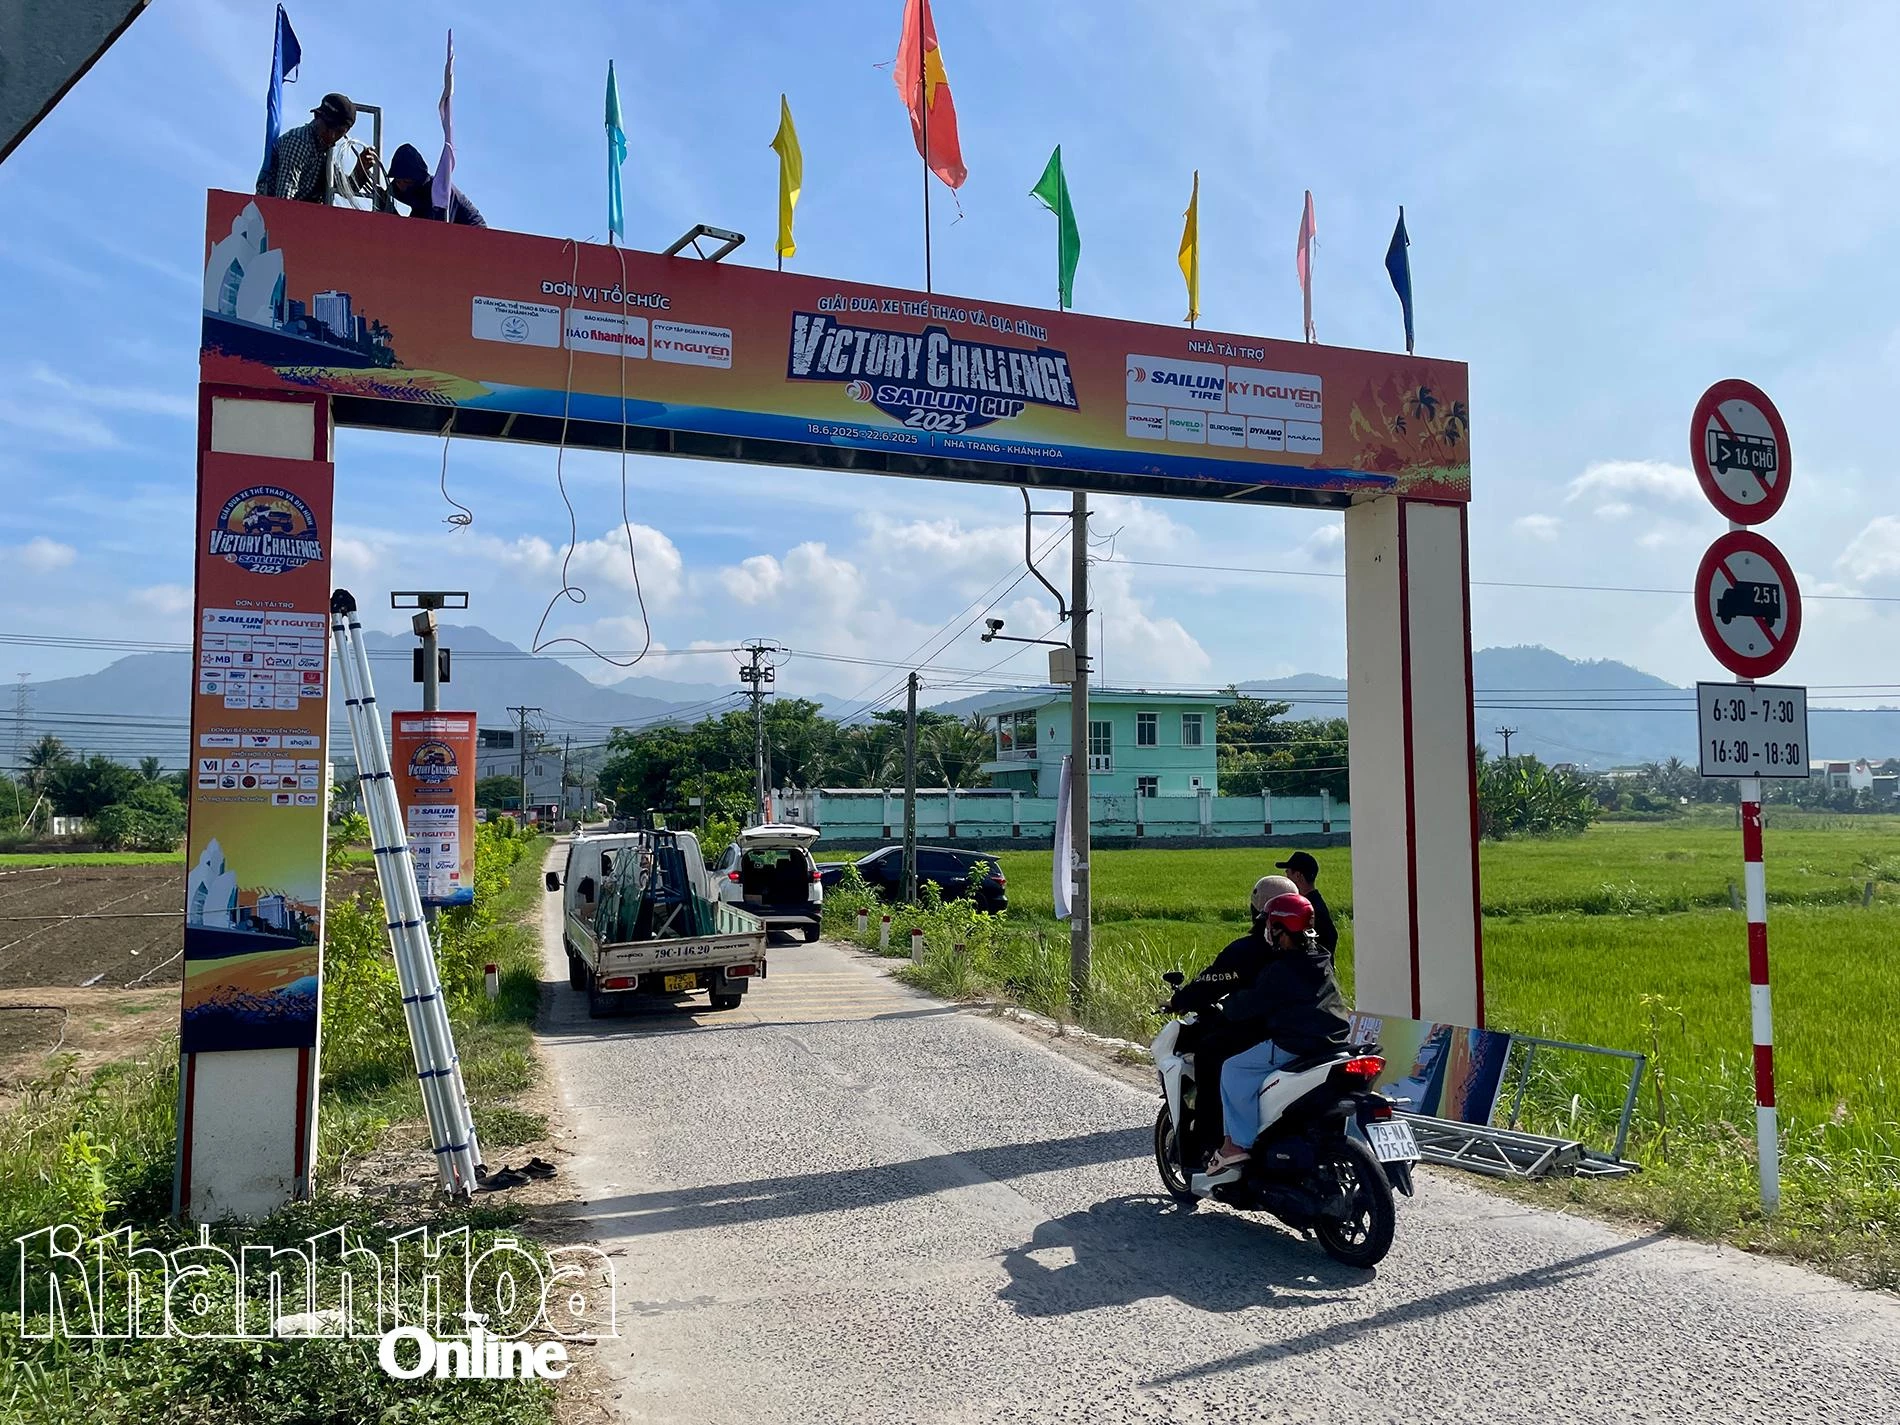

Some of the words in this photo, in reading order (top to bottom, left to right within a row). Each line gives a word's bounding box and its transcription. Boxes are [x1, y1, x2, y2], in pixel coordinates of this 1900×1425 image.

[542, 281, 578, 297] ĐƠN
[582, 286, 597, 303] VỊ
[600, 284, 623, 303] TỔ
[625, 292, 670, 309] CHỨC
[818, 293, 847, 311] GIẢI
[850, 297, 878, 312] ĐUA
[881, 299, 900, 314] XE
[902, 299, 929, 317] THỂ
[931, 304, 967, 322] THAO
[969, 309, 988, 327] VÀ
[990, 315, 1013, 333] ĐỊA
[1016, 319, 1047, 341] HÌNH
[1188, 340, 1215, 354] NHÀ
[1217, 342, 1237, 357] TÀI
[1238, 347, 1265, 362] TRỢ
[927, 332, 1076, 406] CHALLENGE
[1151, 370, 1225, 391] SAILUN
[876, 385, 977, 414] SAILUN
[981, 396, 1024, 420] CUP
[1189, 390, 1222, 401] TIRE
[903, 409, 969, 434] 2025
[1250, 427, 1282, 437] DYNAMO
[943, 439, 965, 449] NHA
[967, 441, 1000, 453] TRANG
[1007, 445, 1041, 456] KHÁNH
[1042, 448, 1063, 458] HÒA
[1735, 447, 1748, 465] 16
[1752, 446, 1774, 468] CHỖ
[265, 487, 285, 497] THAO
[262, 533, 324, 560] CHALLENGE
[238, 554, 286, 565] SAILUN
[286, 557, 310, 567] CUP
[249, 564, 282, 574] 2025
[1772, 589, 1778, 604] t
[218, 615, 264, 625] SAILUN
[215, 656, 231, 664] MB
[1713, 698, 1746, 722] 6:30
[1762, 700, 1794, 723] 7:30
[1711, 739, 1748, 764] 16:30
[1764, 742, 1800, 765] 18:30
[1373, 1124, 1408, 1142] 79-NA
[1377, 1141, 1417, 1159] 175.46
